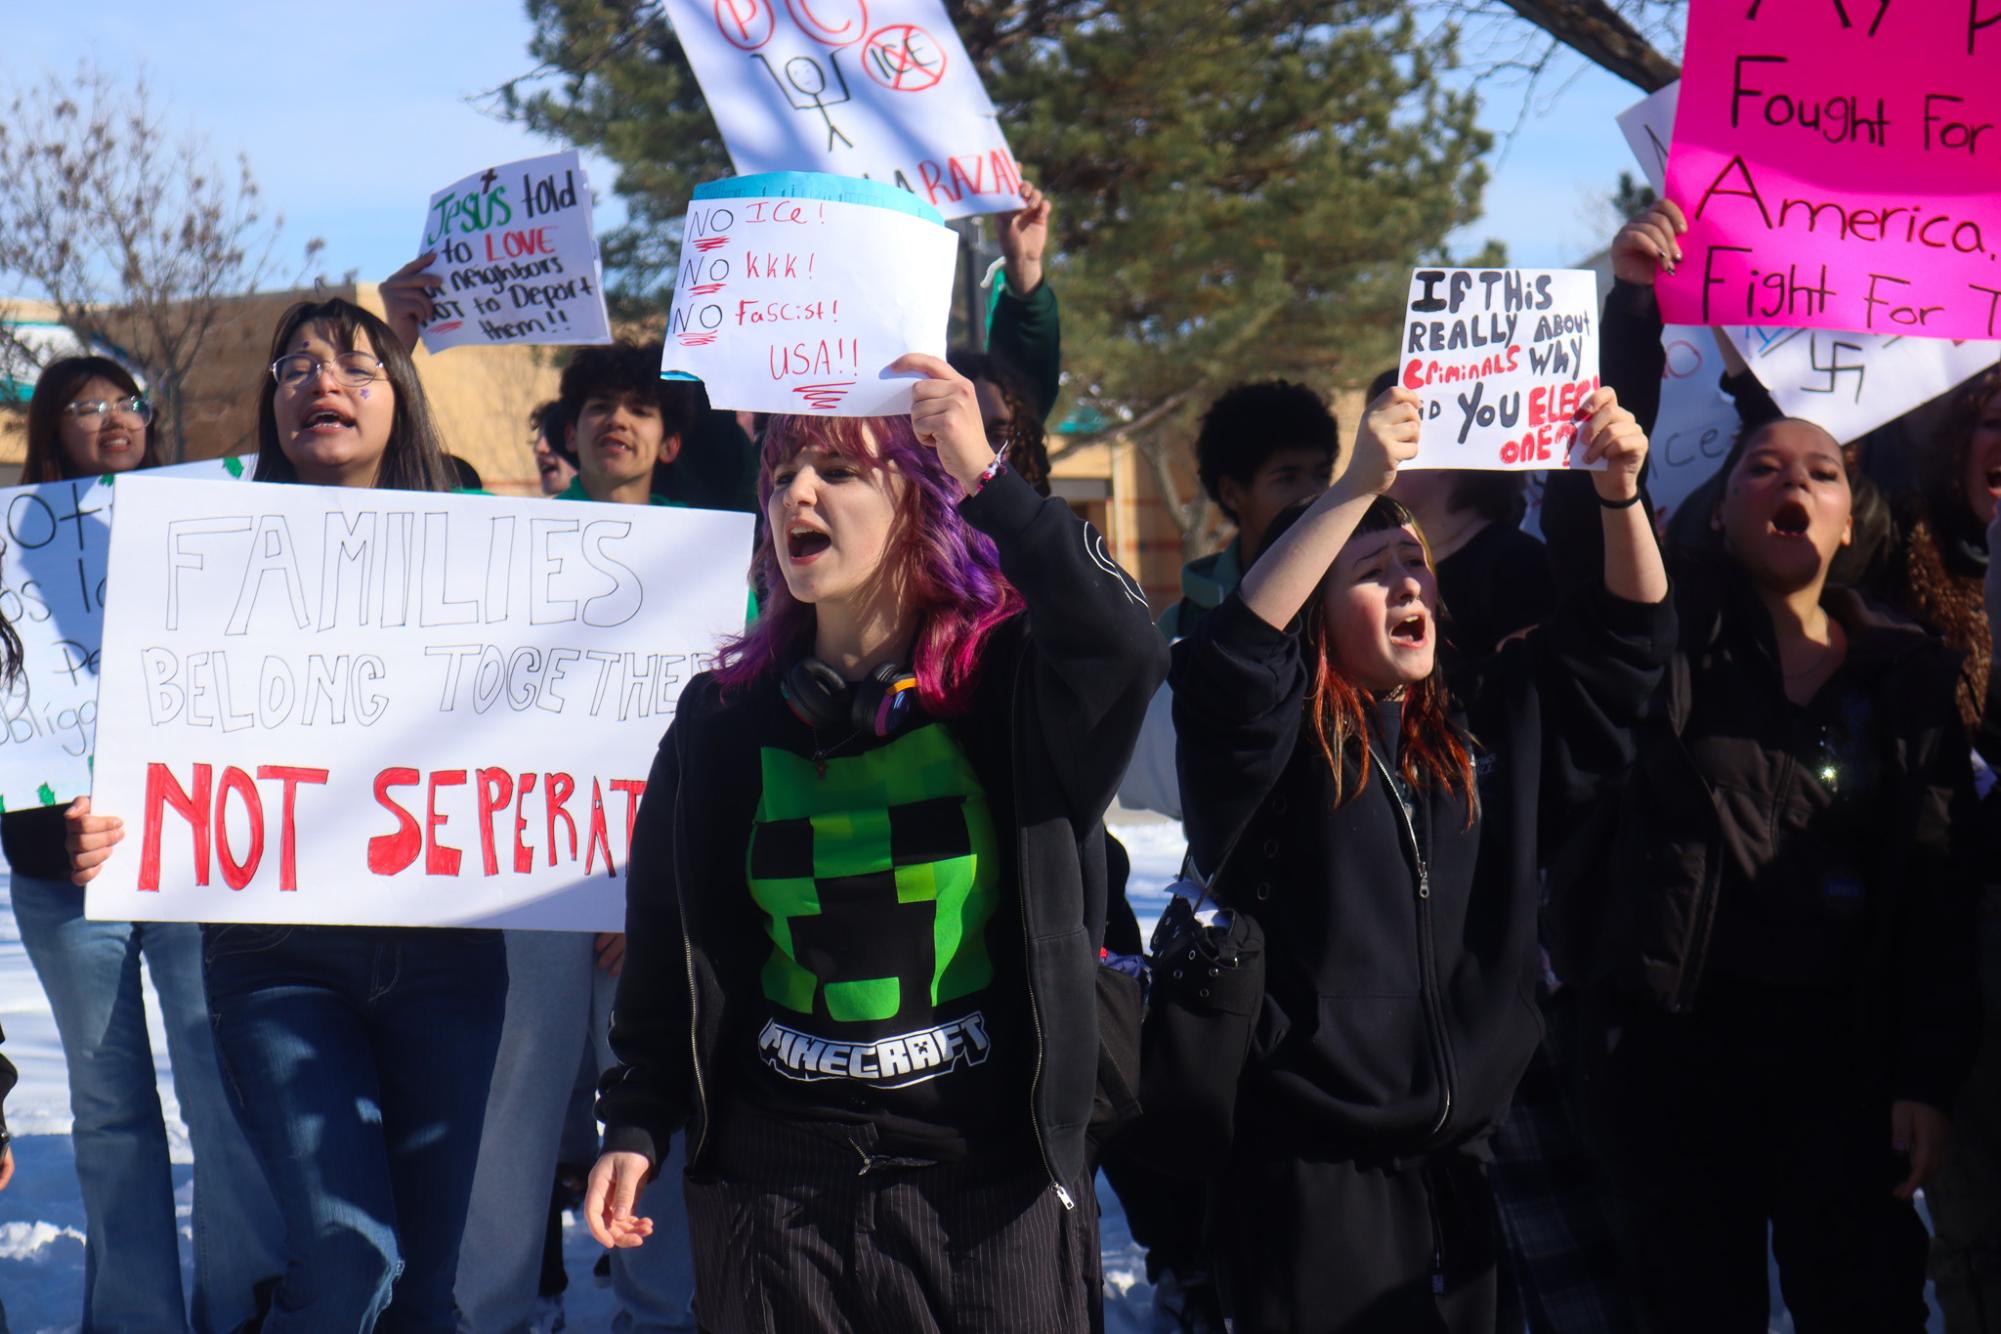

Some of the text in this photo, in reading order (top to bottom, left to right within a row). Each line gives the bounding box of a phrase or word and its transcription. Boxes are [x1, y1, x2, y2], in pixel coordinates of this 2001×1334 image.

[1731, 55, 1994, 154] Fought For
[522, 170, 577, 218] told
[1695, 154, 1997, 261] America.
[441, 225, 559, 264] to LOVE
[688, 207, 734, 242] NO
[450, 257, 564, 295] neighbors
[681, 255, 730, 288] NO
[1703, 246, 1836, 324] Fight
[1864, 274, 1944, 329] For
[473, 297, 500, 315] to
[508, 276, 593, 310] Deport
[672, 303, 723, 334] NO
[1408, 313, 1517, 353] REALLY
[770, 338, 858, 380] USA!!
[166, 511, 643, 636] FAMILIES
[141, 646, 389, 733] BELONG
[138, 762, 329, 892] NOT
